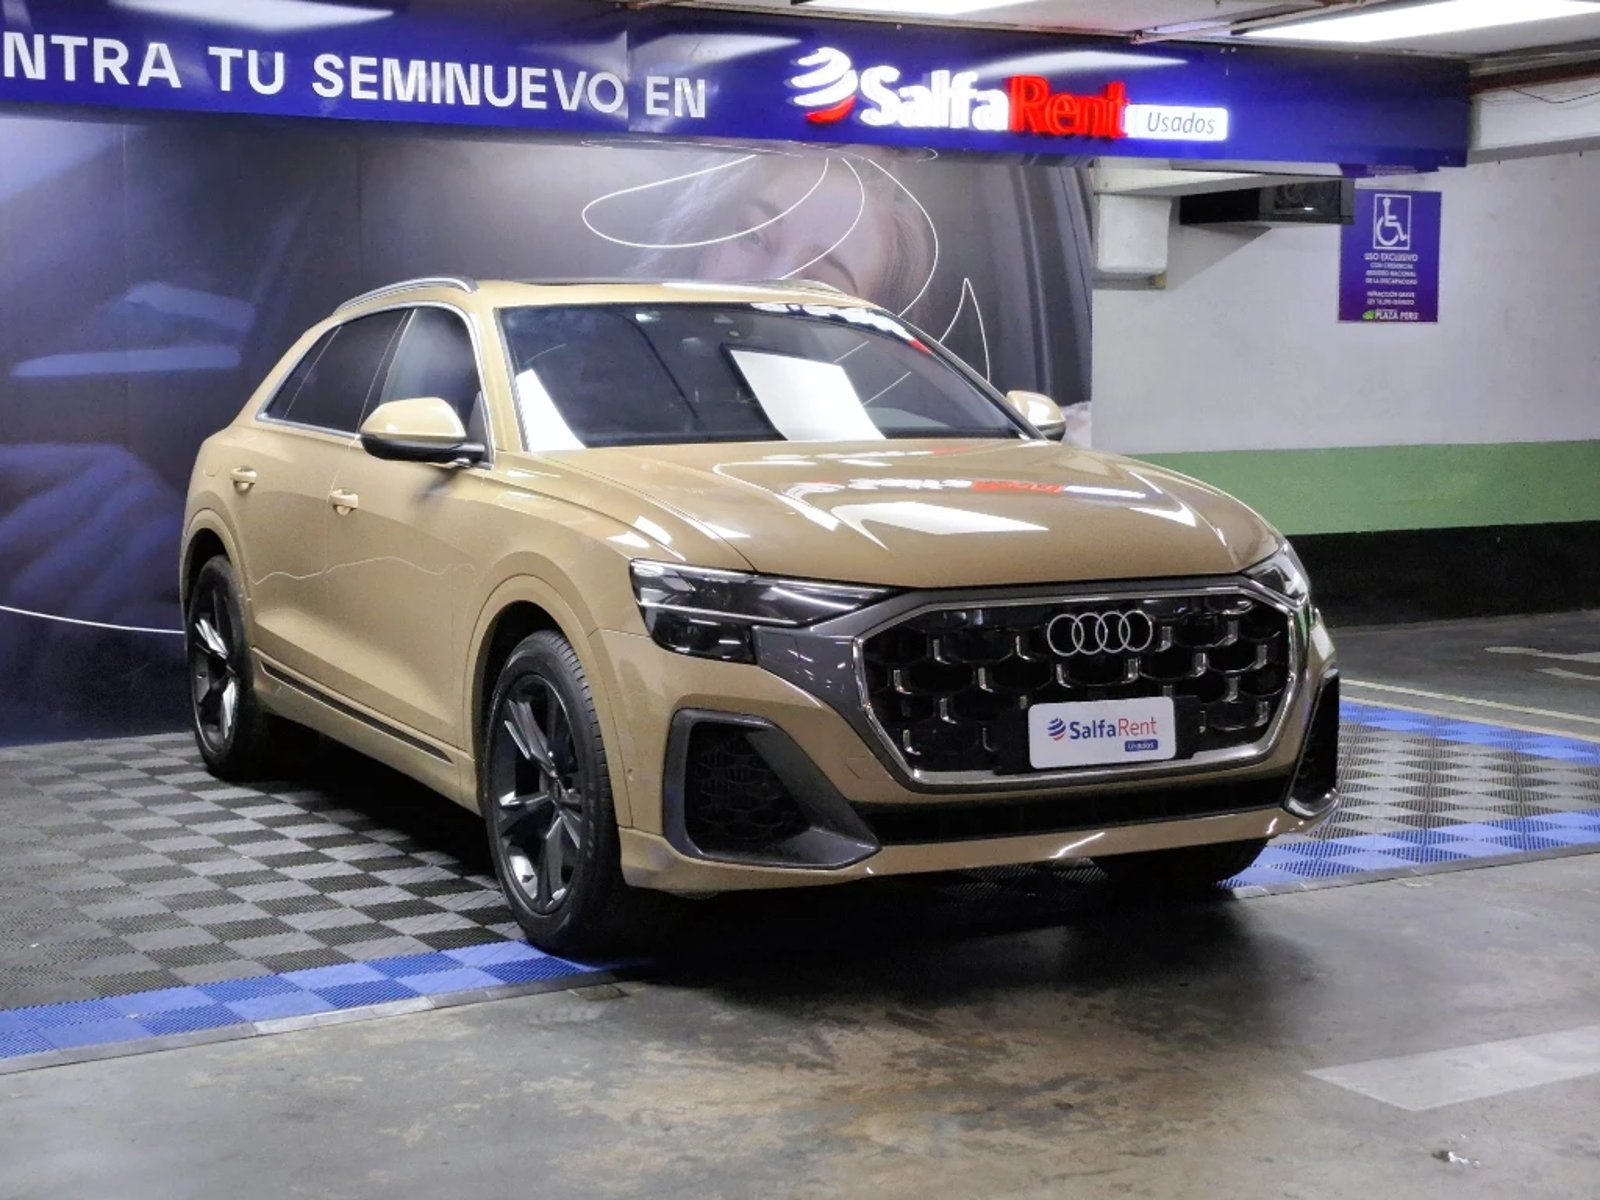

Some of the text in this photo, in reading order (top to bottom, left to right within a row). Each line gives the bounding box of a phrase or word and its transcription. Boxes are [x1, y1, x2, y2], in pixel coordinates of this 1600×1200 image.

[3, 31, 706, 118] NTRA TU SEMINUEVO EN
[859, 65, 1130, 141] SalfaRent
[1146, 111, 1216, 135] Usados
[1380, 252, 1419, 262] EXCLUSIVO
[1375, 311, 1399, 320] PLAZA
[1069, 716, 1158, 740] SalfaRent
